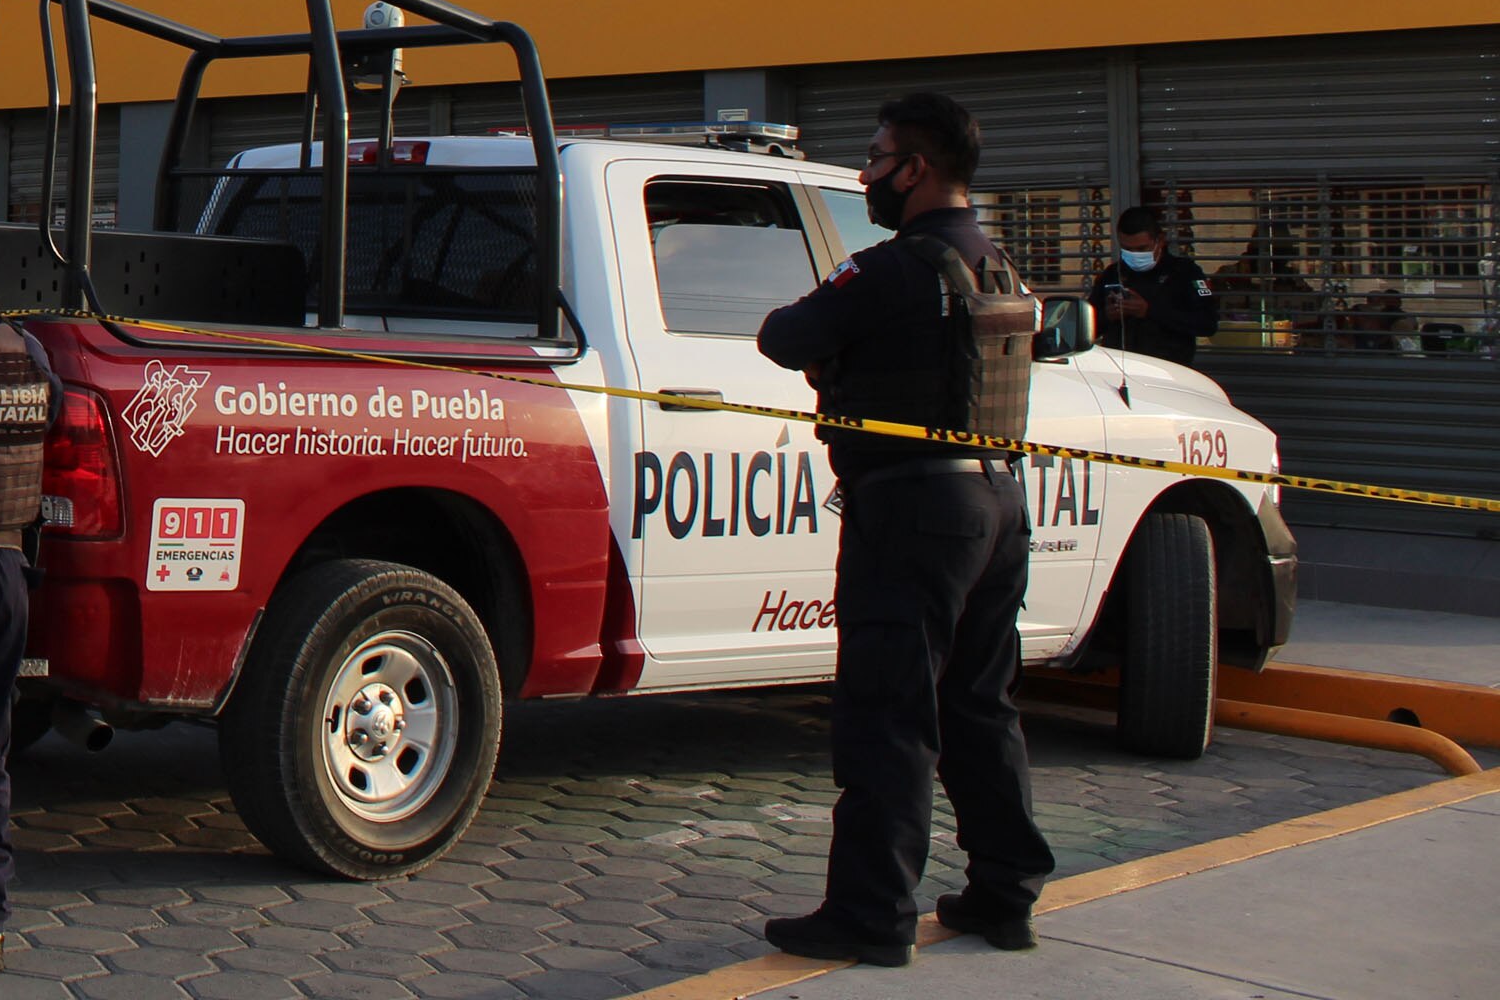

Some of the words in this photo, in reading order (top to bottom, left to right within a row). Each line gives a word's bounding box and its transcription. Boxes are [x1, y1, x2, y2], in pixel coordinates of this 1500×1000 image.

[214, 382, 358, 416] Gobierno
[368, 386, 404, 418] de
[411, 388, 505, 420] Puebla
[215, 425, 290, 456] Hacer
[294, 425, 387, 456] historia.
[392, 428, 459, 457] Hacer
[461, 427, 529, 464] futuro.
[1177, 430, 1228, 476] 1629
[631, 422, 818, 540] POLICÍA
[164, 511, 230, 535] 911
[156, 550, 235, 561] EMERGENCIAS
[751, 590, 839, 632] Hace
